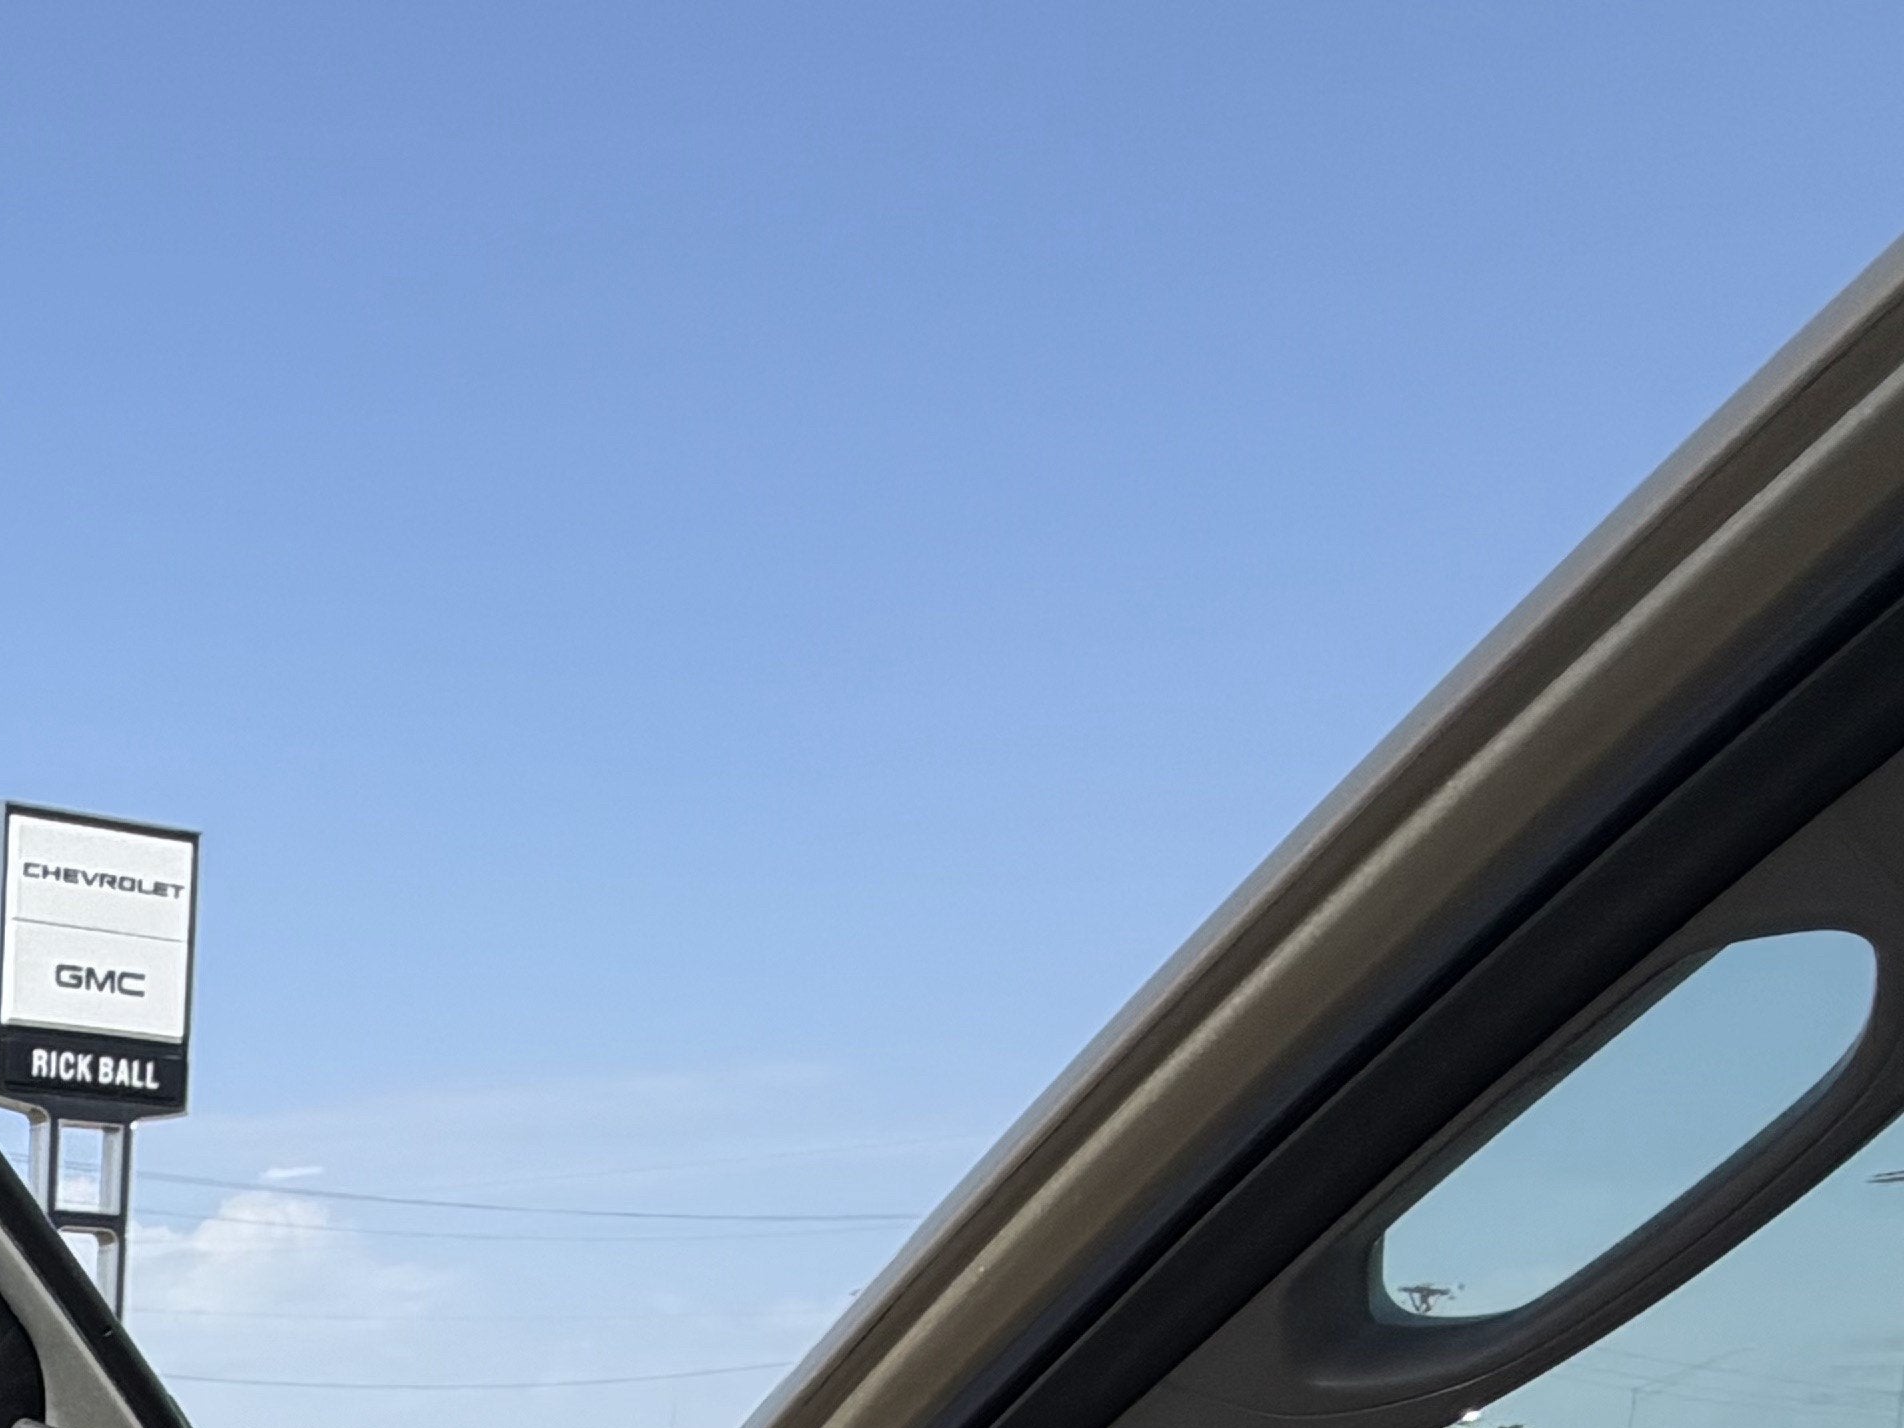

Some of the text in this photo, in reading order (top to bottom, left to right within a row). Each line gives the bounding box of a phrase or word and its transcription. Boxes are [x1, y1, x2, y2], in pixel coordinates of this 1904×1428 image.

[23, 862, 184, 898] CHEVROLET
[55, 964, 145, 997] GMC
[32, 1049, 159, 1089] RICK BALL
